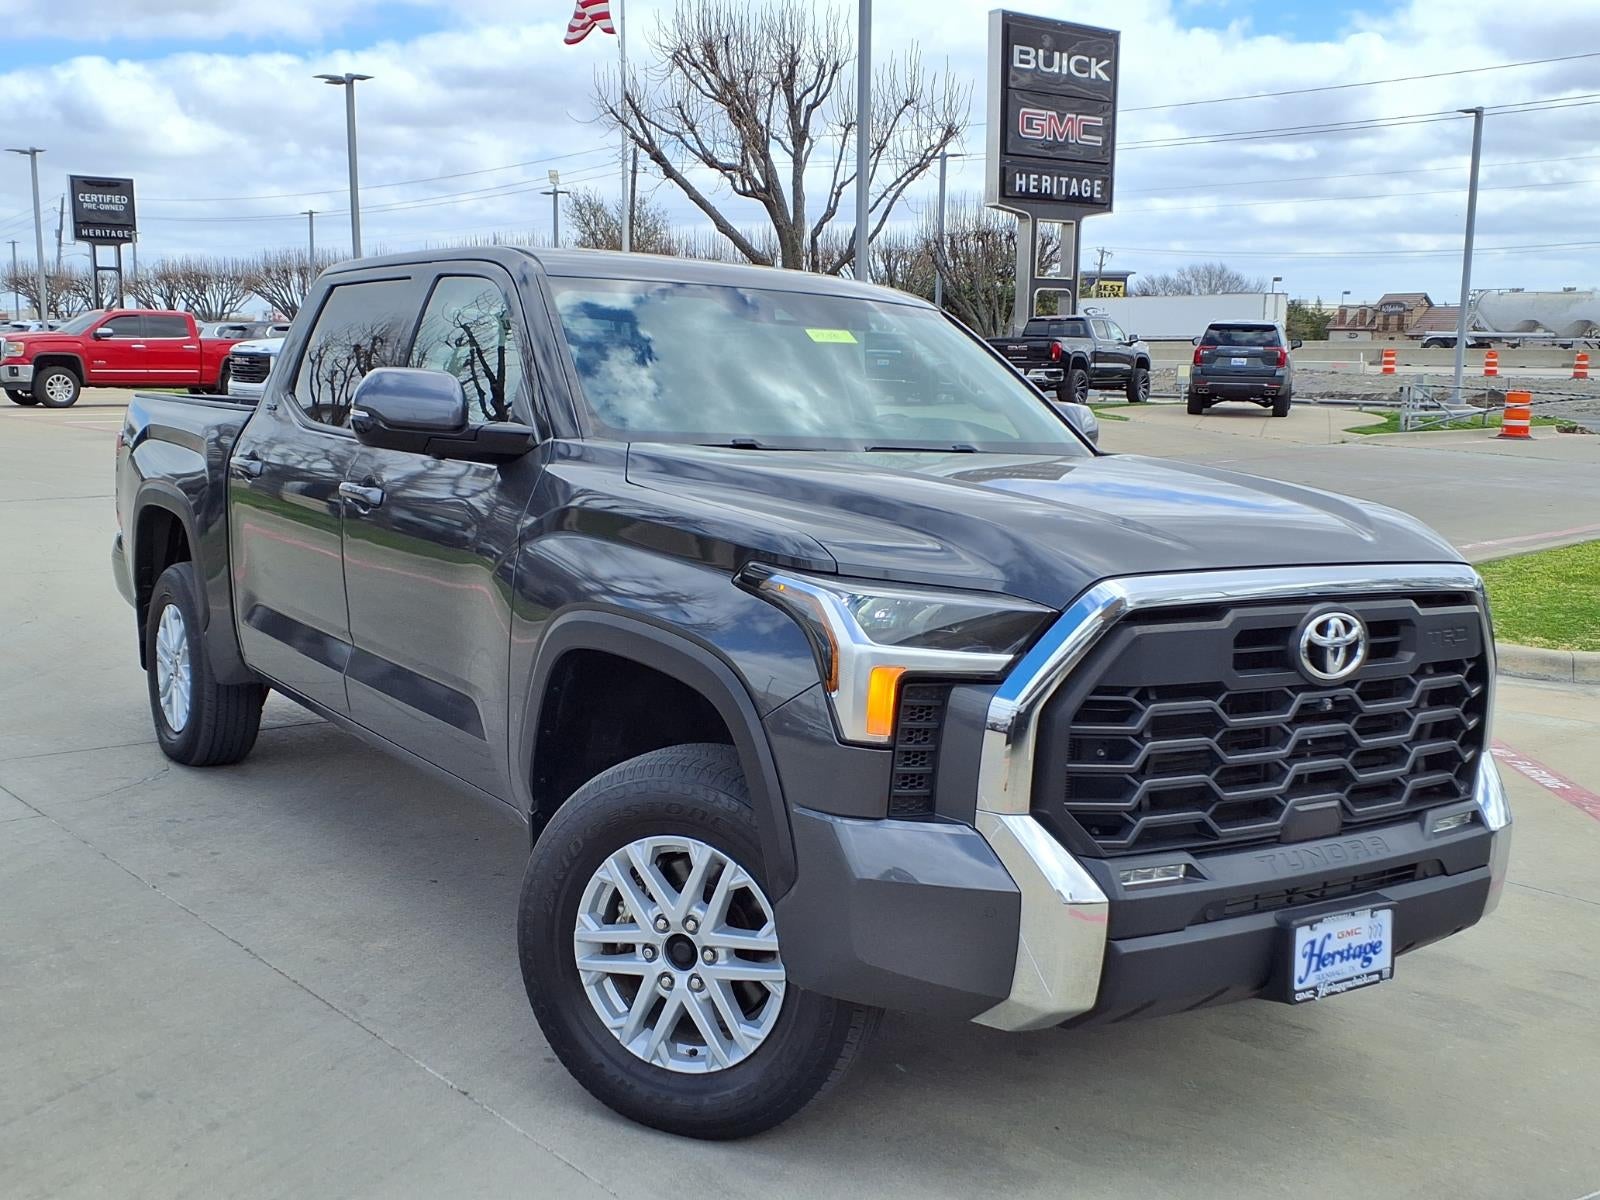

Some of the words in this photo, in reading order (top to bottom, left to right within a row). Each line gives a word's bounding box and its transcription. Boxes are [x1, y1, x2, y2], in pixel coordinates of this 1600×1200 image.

[1013, 44, 1110, 82] BUICK
[1019, 107, 1103, 146] GMC
[79, 193, 128, 204] CERTIFIED
[1015, 172, 1102, 199] HERITAGE
[83, 203, 125, 211] PRE-OWNED
[82, 229, 129, 238] HERITAGE
[1254, 836, 1391, 874] TUNDRA
[1337, 927, 1362, 939] GMC
[1297, 932, 1383, 985] Heritage
